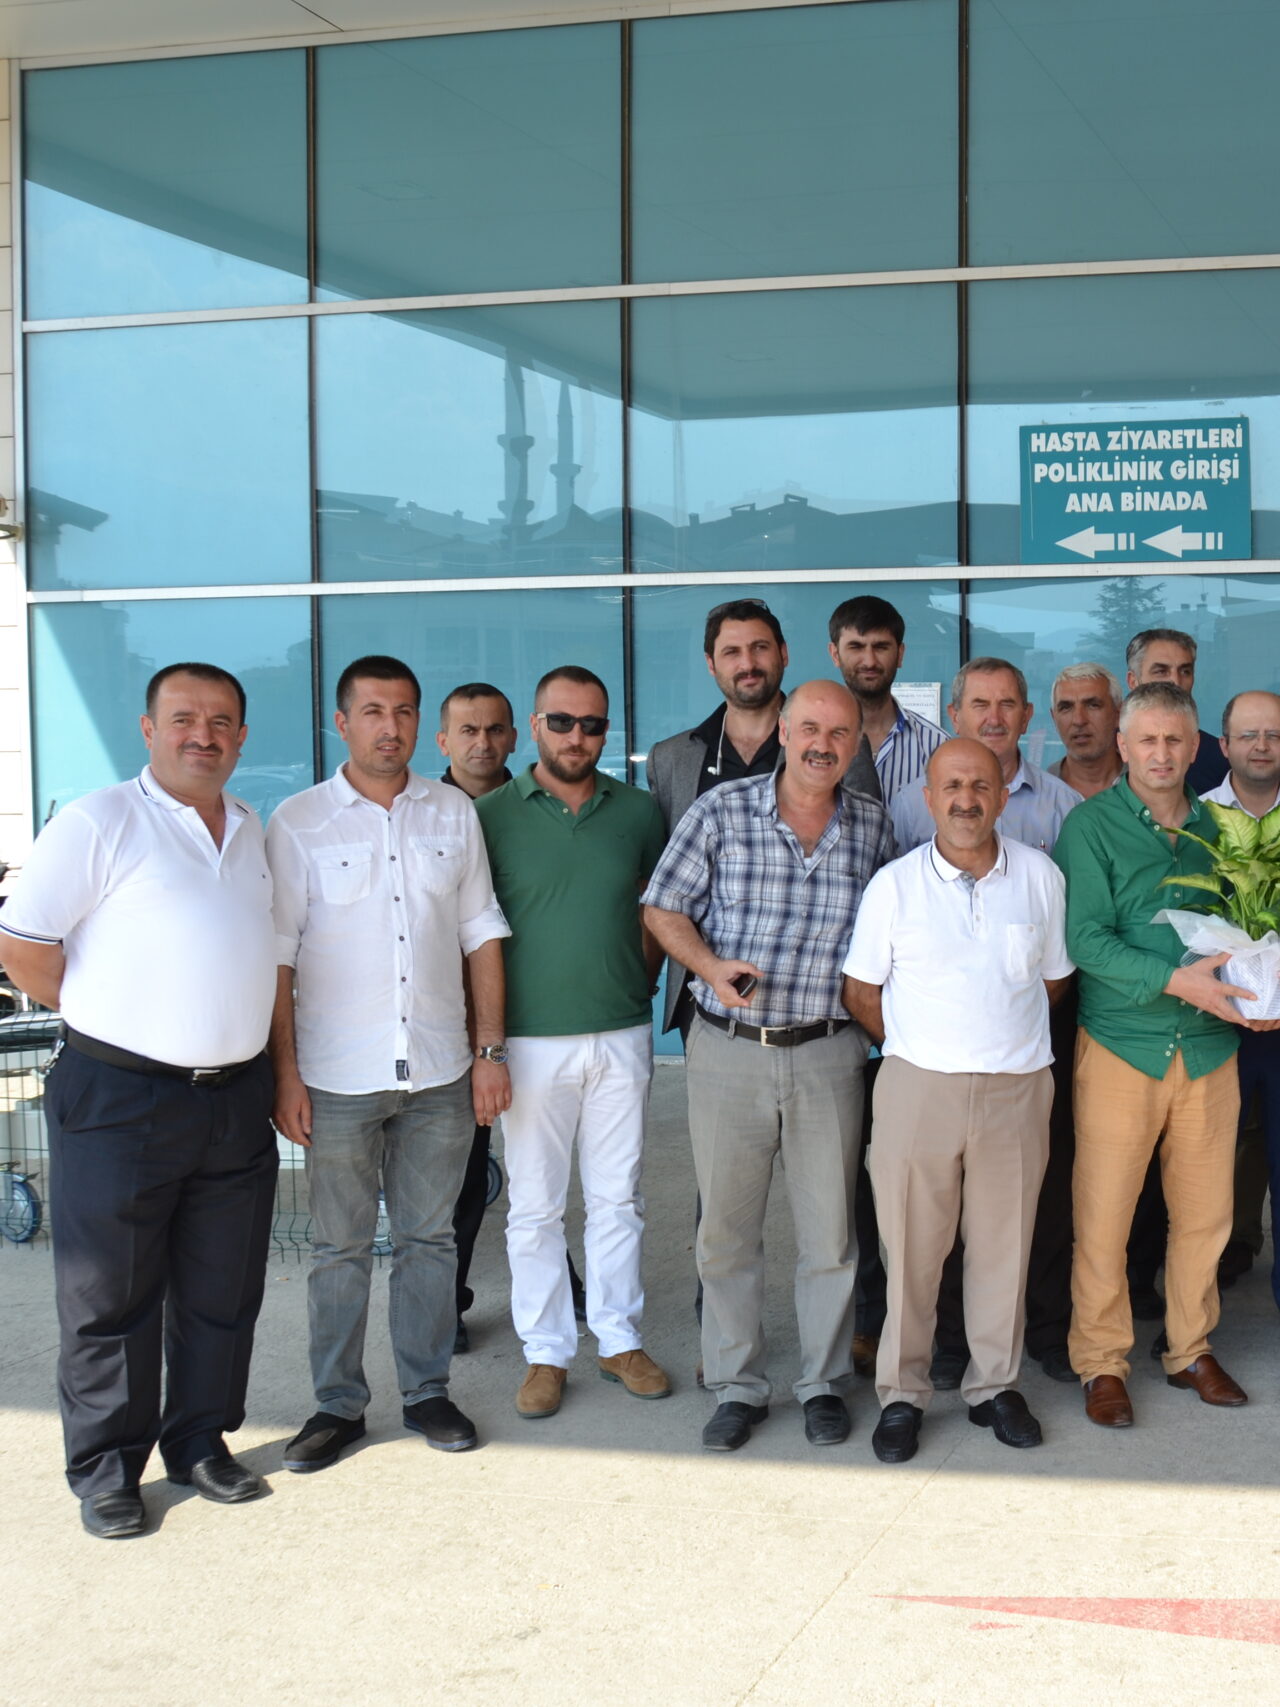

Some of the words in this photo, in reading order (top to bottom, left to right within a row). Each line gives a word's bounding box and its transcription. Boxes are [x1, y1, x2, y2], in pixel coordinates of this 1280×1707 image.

[1030, 431, 1102, 453] HASTA
[1106, 423, 1244, 451] ZİYARETLERİ
[1034, 455, 1164, 484] POLİKLİNİK
[1169, 452, 1240, 485] GİRİŞİ
[1064, 491, 1115, 513] ANA
[1120, 485, 1208, 512] BİNADA
